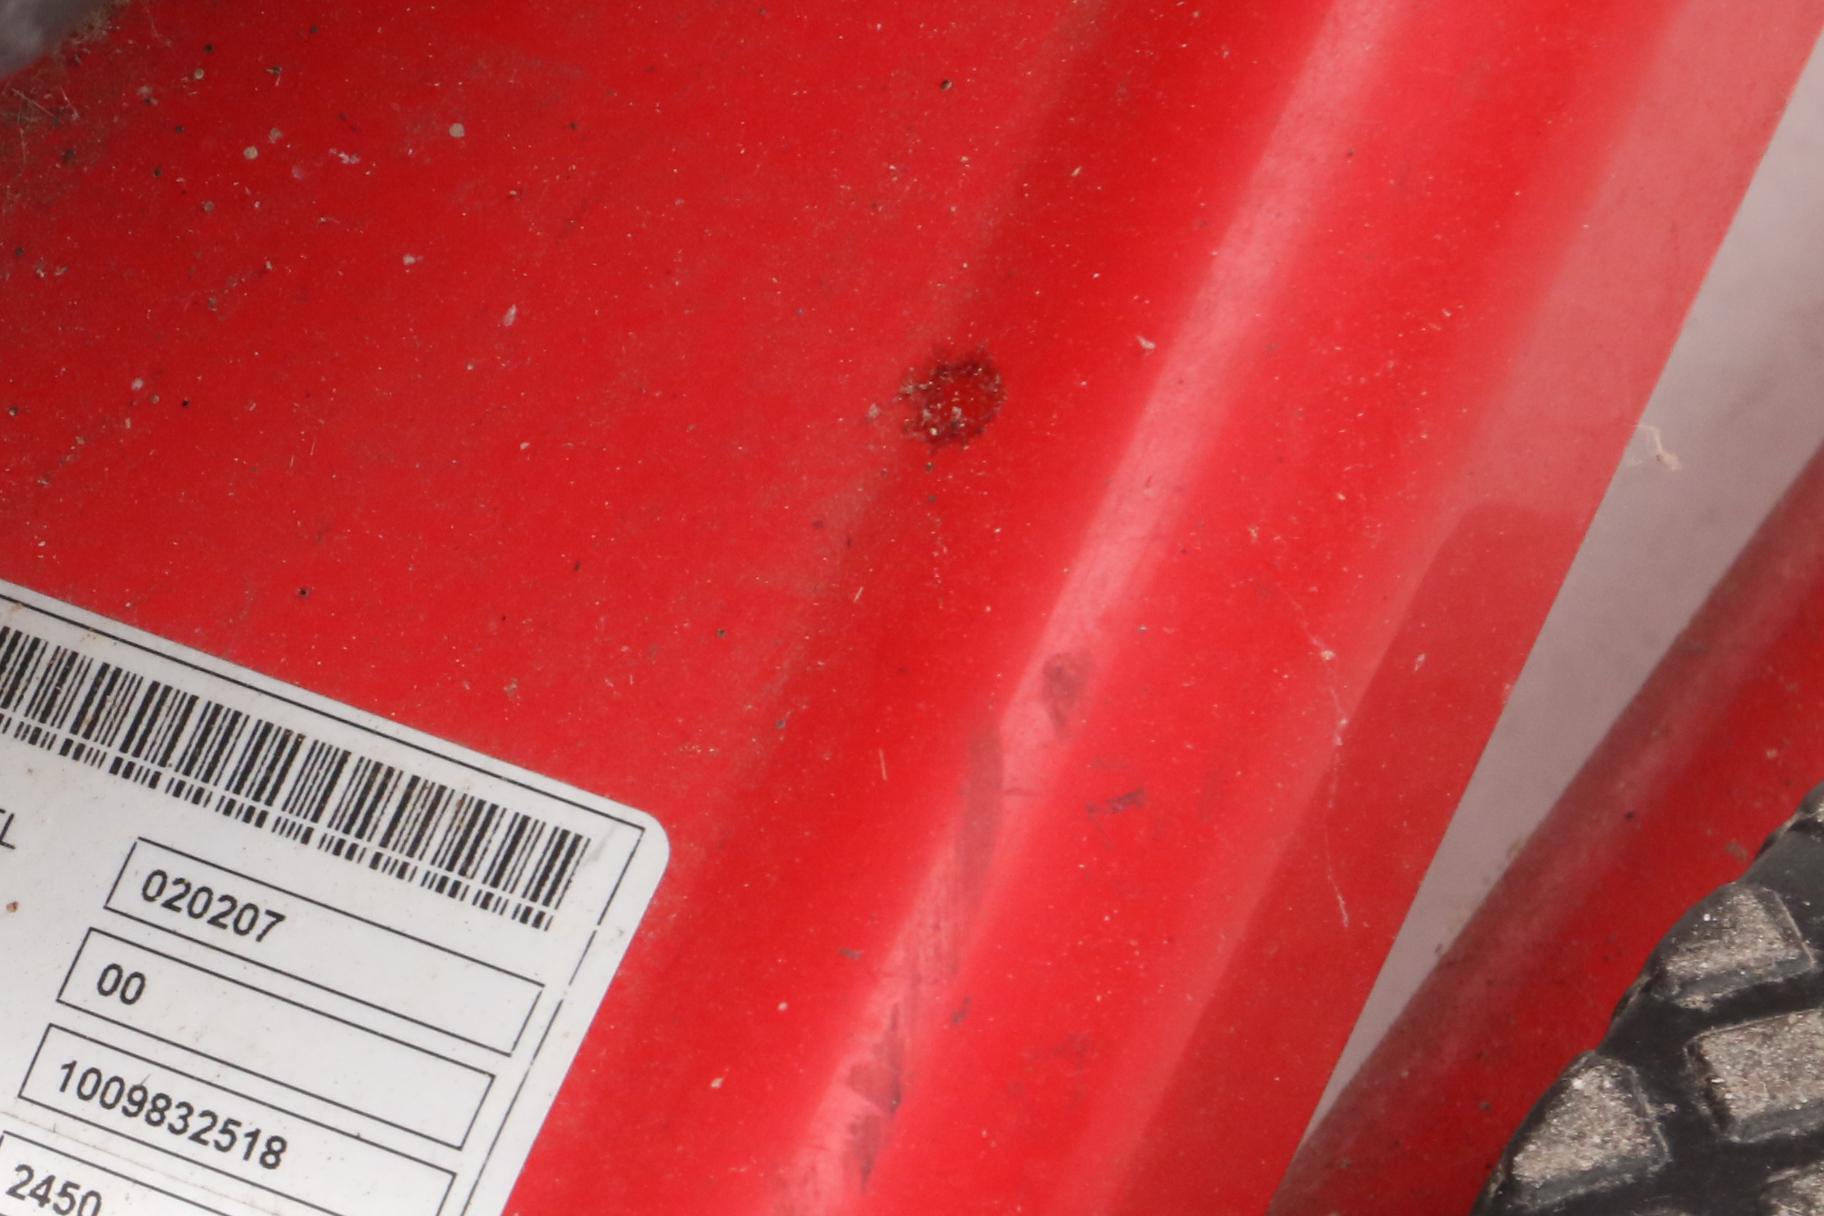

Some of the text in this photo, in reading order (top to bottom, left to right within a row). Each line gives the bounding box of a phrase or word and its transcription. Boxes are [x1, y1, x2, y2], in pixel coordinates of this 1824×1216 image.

[142, 870, 286, 942] 020207
[97, 963, 146, 1005] 00
[60, 1061, 287, 1169] 1009832518
